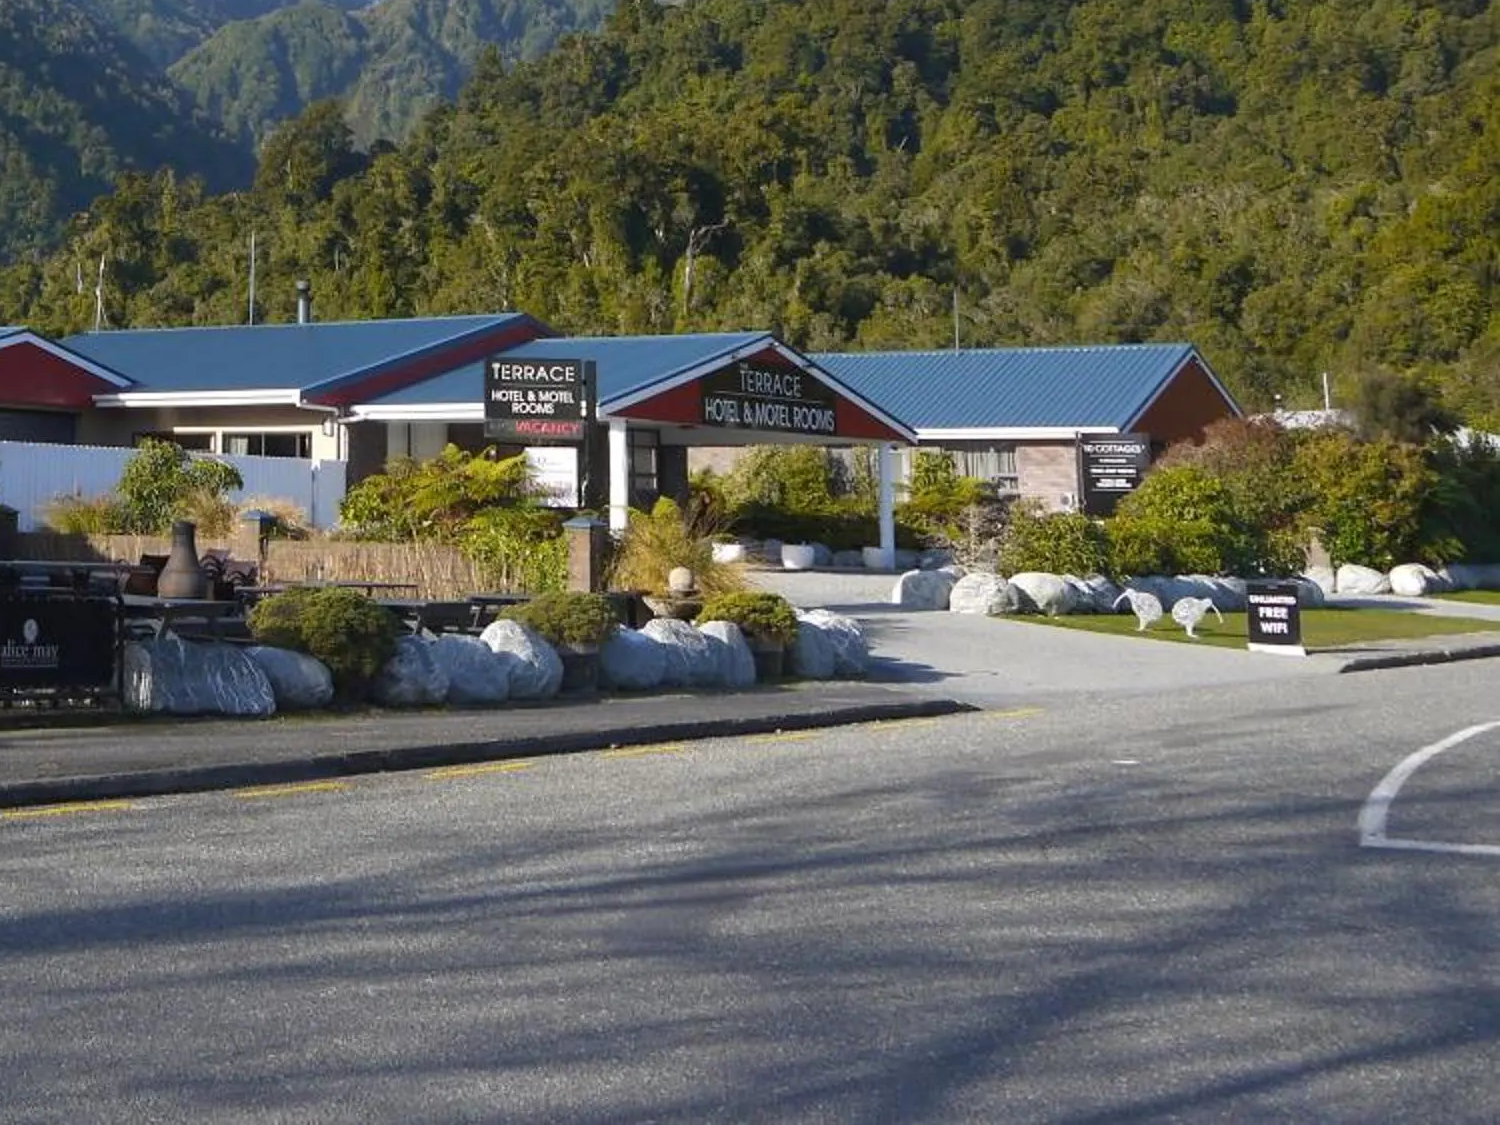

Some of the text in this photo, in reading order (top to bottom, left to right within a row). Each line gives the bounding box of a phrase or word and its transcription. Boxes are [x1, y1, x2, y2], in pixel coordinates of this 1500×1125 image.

[491, 362, 575, 383] TERRACE
[740, 370, 801, 397] TERRACE
[491, 389, 575, 404] HOTEL & MOTEL
[511, 402, 555, 415] ROOMS
[704, 396, 835, 432] HOTEL & MOTEL ROOMS
[515, 420, 581, 433] VACANCY
[1258, 606, 1289, 620] FREE
[1260, 621, 1289, 634] WIFI
